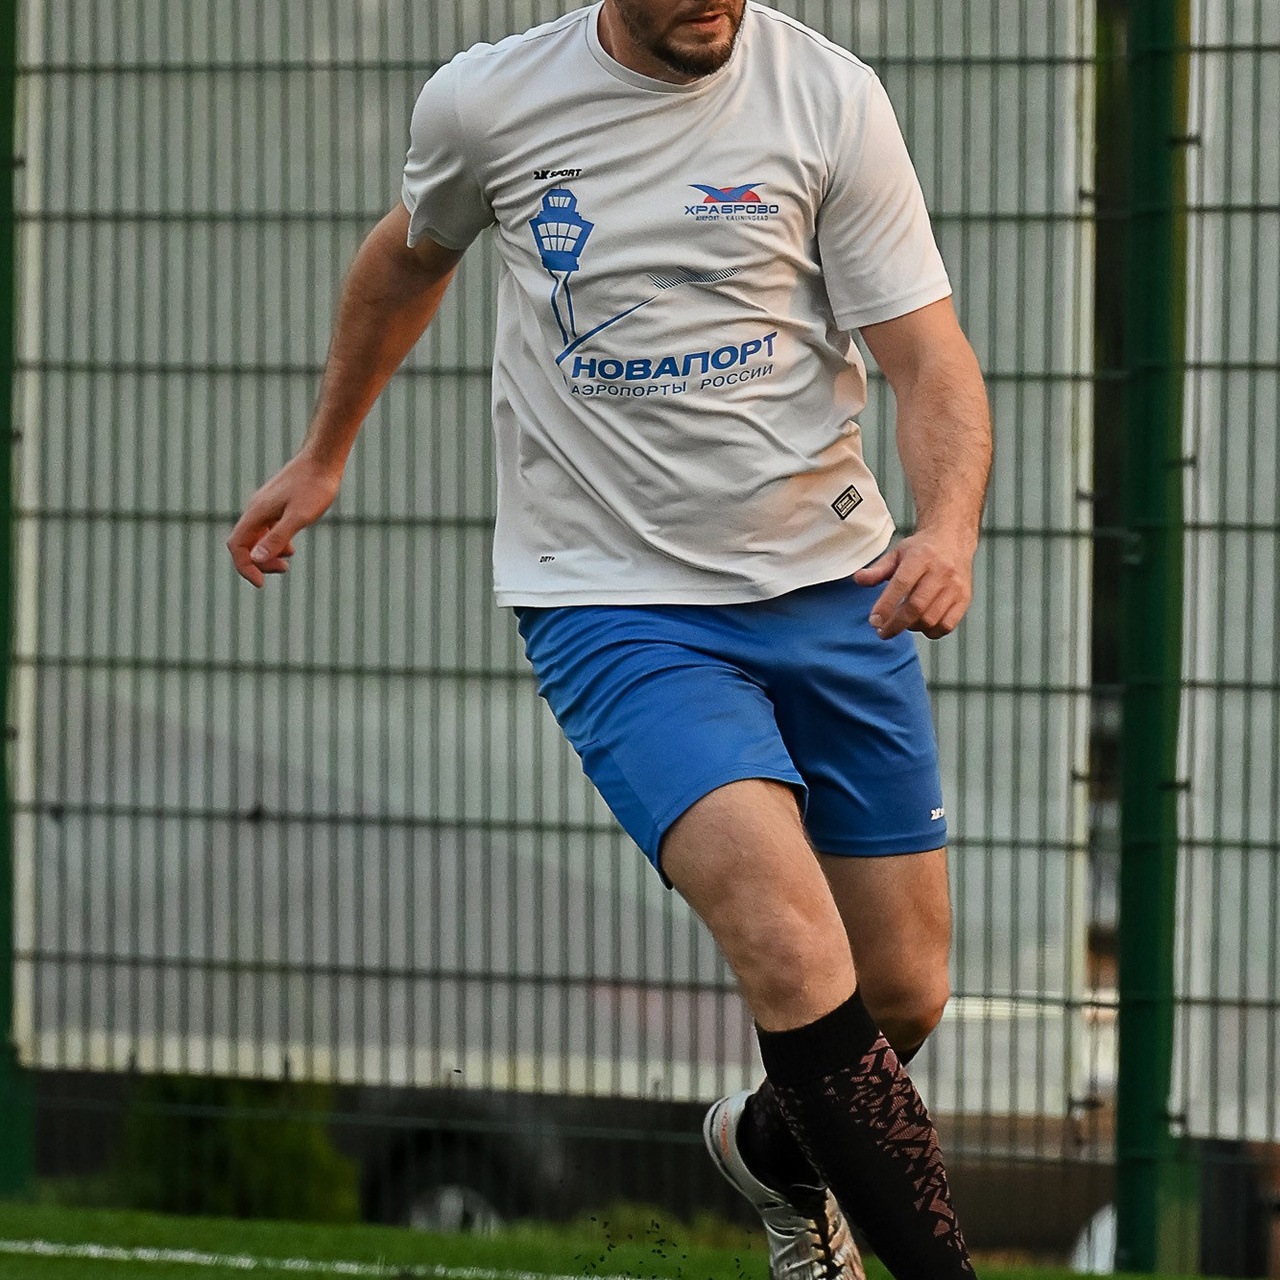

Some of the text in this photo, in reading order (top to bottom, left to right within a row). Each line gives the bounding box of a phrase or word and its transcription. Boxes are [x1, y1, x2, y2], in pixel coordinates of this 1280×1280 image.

[549, 168, 582, 178] SPORT
[684, 204, 779, 215] ХРАБРОВО
[571, 331, 778, 381] НОВАПОРТ
[571, 363, 774, 397] АЭРОПОРТЫ РОССИИ
